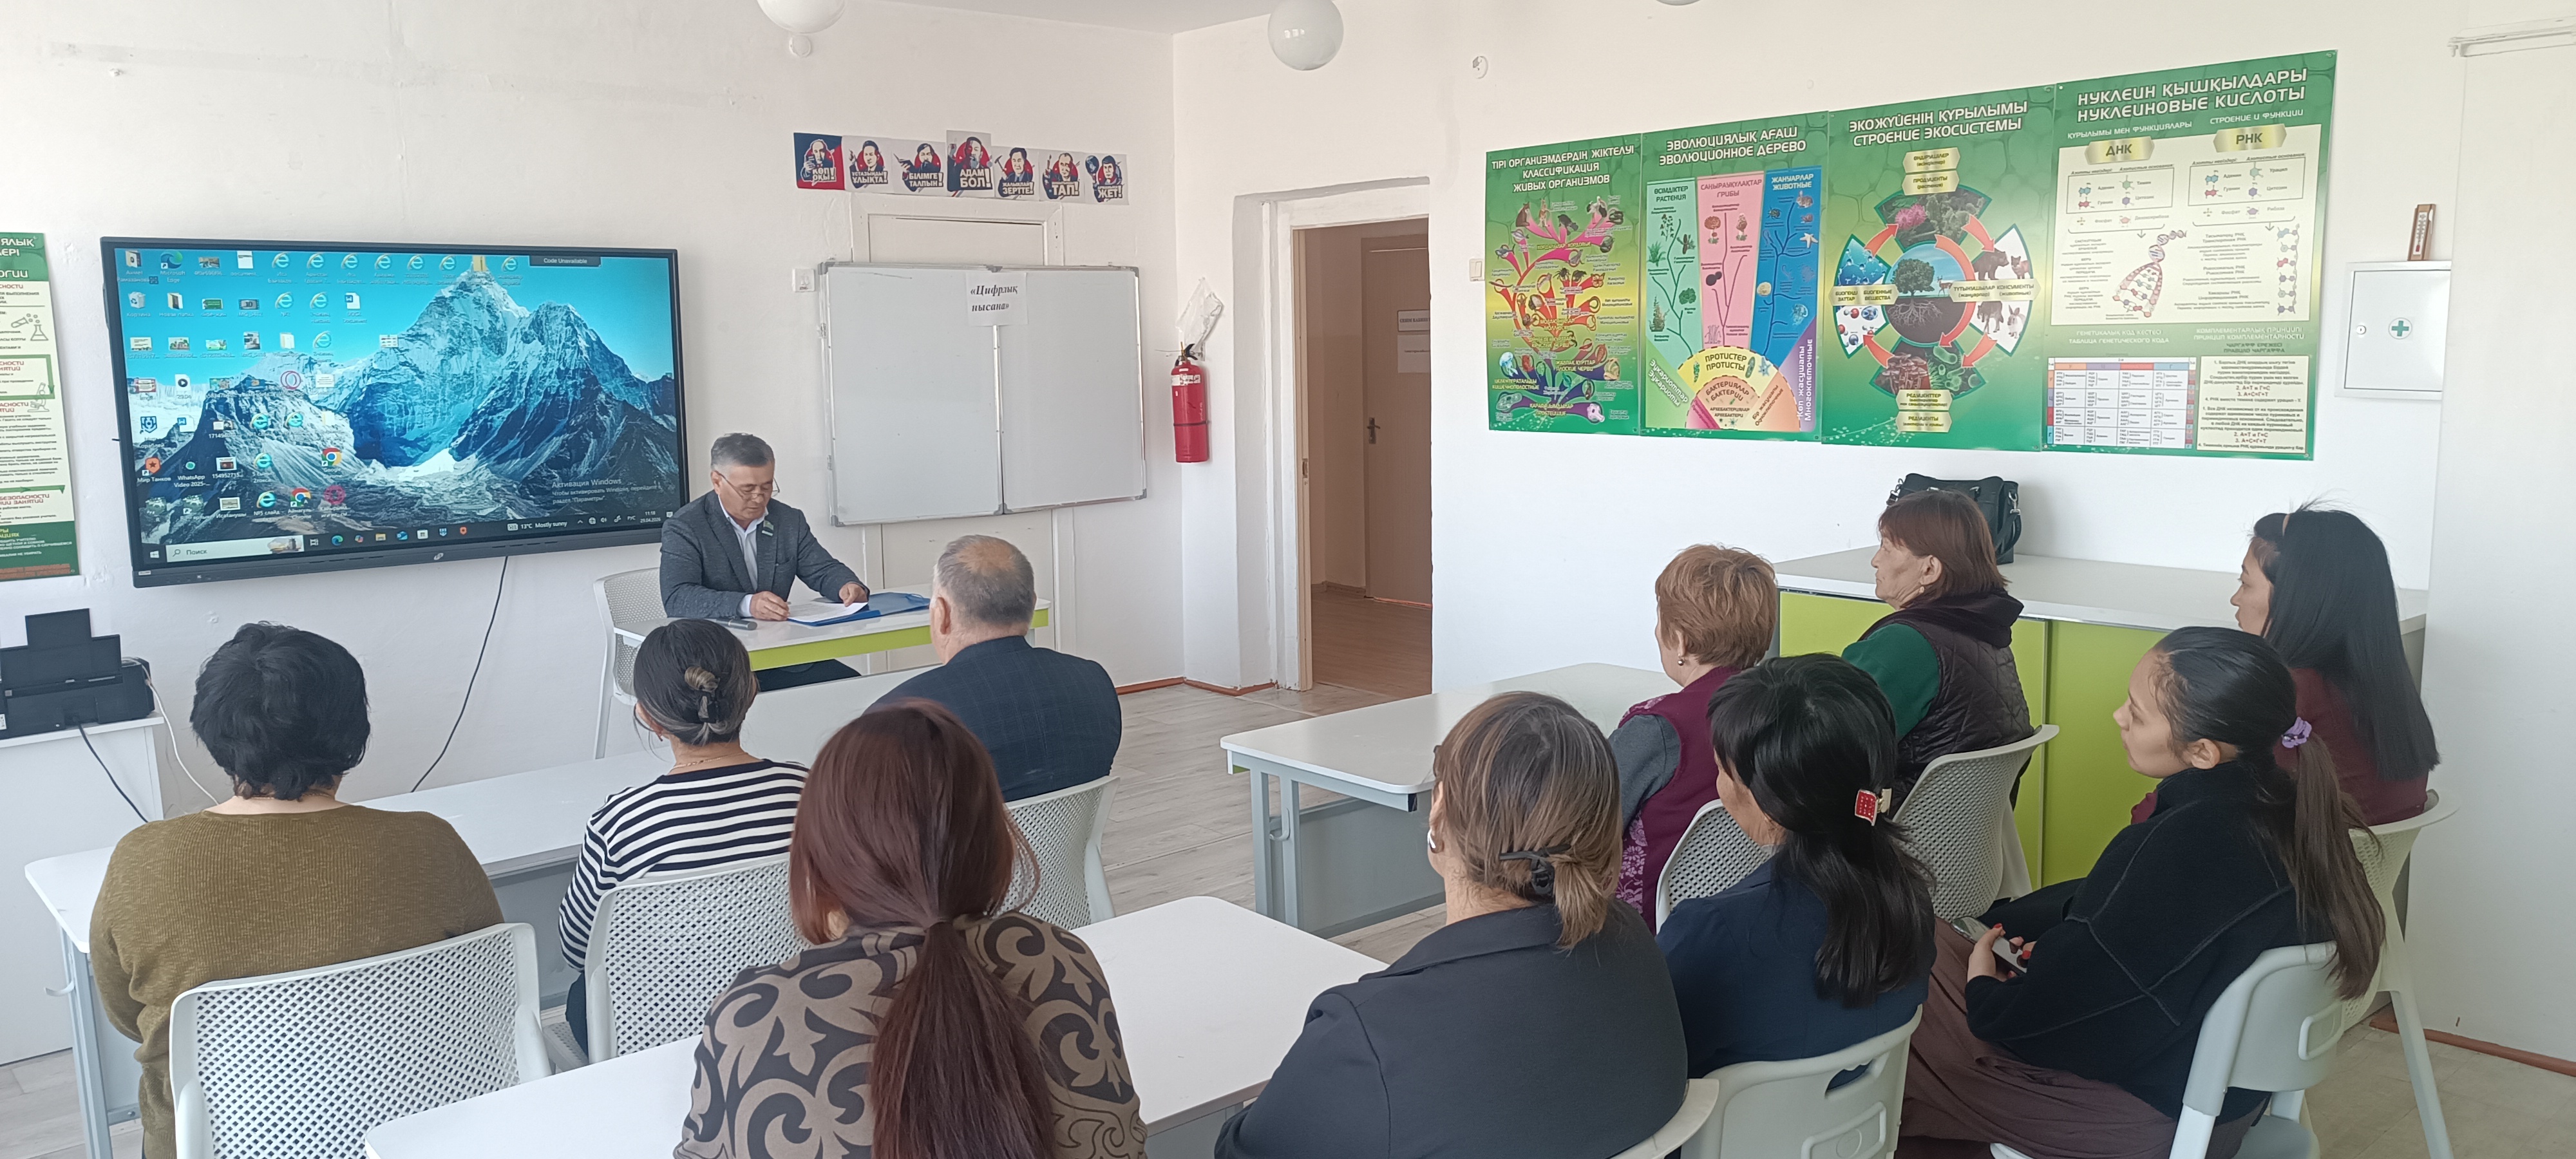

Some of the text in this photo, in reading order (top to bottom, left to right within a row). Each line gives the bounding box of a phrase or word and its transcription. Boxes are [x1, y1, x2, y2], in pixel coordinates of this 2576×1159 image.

[2078, 68, 2307, 106] НУКЛЕИН ҚЫШҚЫЛДАРЫ
[2078, 87, 2305, 122] НУКЛЕИНОВЫЕ КИСЛОТЫ
[1849, 112, 1934, 133] ЭКОЖҮЙЕНІҢ
[2210, 114, 2251, 124] СТРОЕНИЕ
[2262, 109, 2304, 119] ФУНКЦИИ
[1853, 118, 2022, 147] СТРОЕНИЕ ЭКОСИСТЕМЫ
[2132, 121, 2192, 133] ФУНКЦИЯЛАРЫ
[1666, 127, 1797, 152] ЭВОЛЮЦИЯЛЫҚ АҒАШ
[2236, 133, 2263, 145] РНК
[1492, 146, 1634, 169] ТІРІ ОРГАНИЗМДЕРДІҢ ЖІКТЕЛУІ
[1659, 140, 1806, 166] ЭВОЛЮЦИОННОЕ ДЕРЕВО
[2105, 144, 2132, 156] ДНК
[960, 169, 991, 188] БОЛ!
[1522, 162, 1600, 179] КЛАССИФИКАЦИЯ
[1513, 174, 1610, 193] ЖИВЫХ ОРГАНИЗМОВ
[1772, 174, 1814, 184] ЖАНУАРЛАР
[1772, 182, 1812, 191] ЖИВОТНЫЕ
[1052, 182, 1079, 196] ТАП!
[1098, 185, 1122, 198] ЖЕТ!
[971, 285, 1018, 296] «Цифрлық
[1705, 352, 1747, 363] ПРОТИСТЕР
[1706, 362, 1746, 371] ПРОТИСТЫ
[1649, 359, 1689, 404] Эукариоттар
[1706, 381, 1750, 395] БАКТЕРИЯЛАР
[1804, 339, 1813, 421] Многоклеточные
[1647, 370, 1681, 407] Эукариоты
[1710, 390, 1744, 401] БАКТЕРИИ
